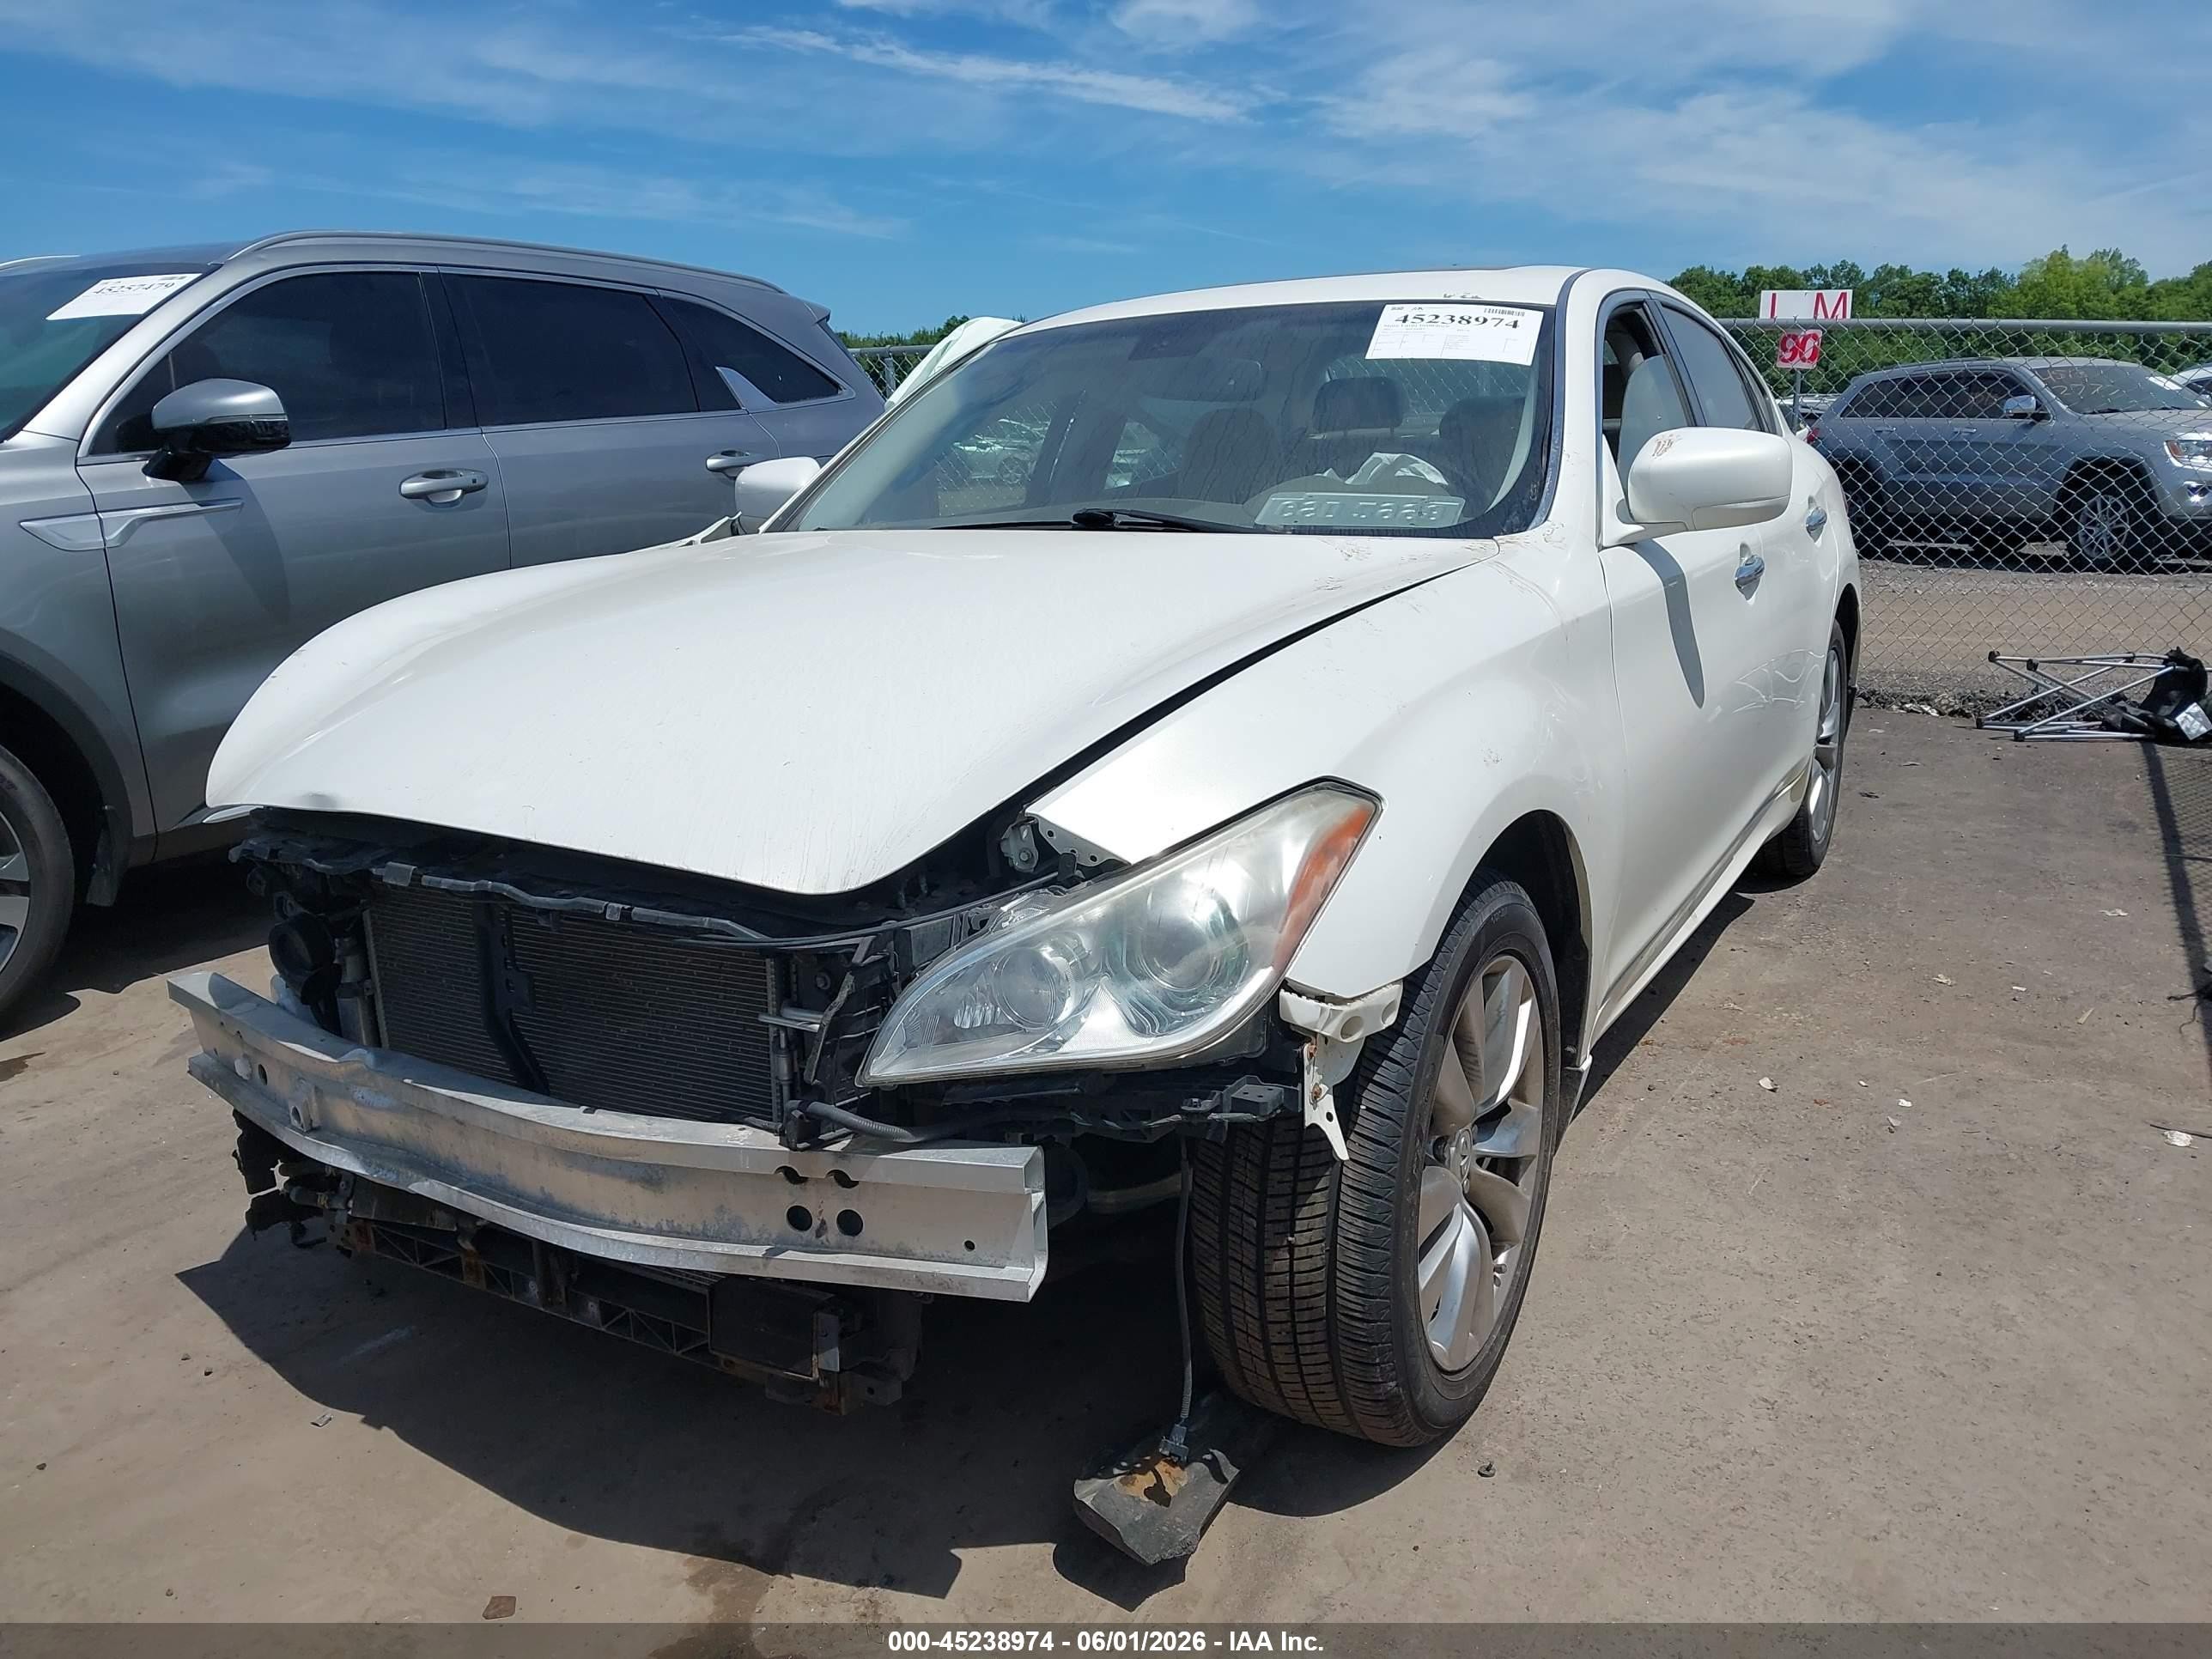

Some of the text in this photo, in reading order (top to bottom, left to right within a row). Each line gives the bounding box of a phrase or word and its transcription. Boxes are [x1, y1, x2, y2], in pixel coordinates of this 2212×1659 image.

[1814, 292, 1847, 319] M
[1395, 313, 1519, 329] 45238974
[1780, 333, 1819, 363] 90
